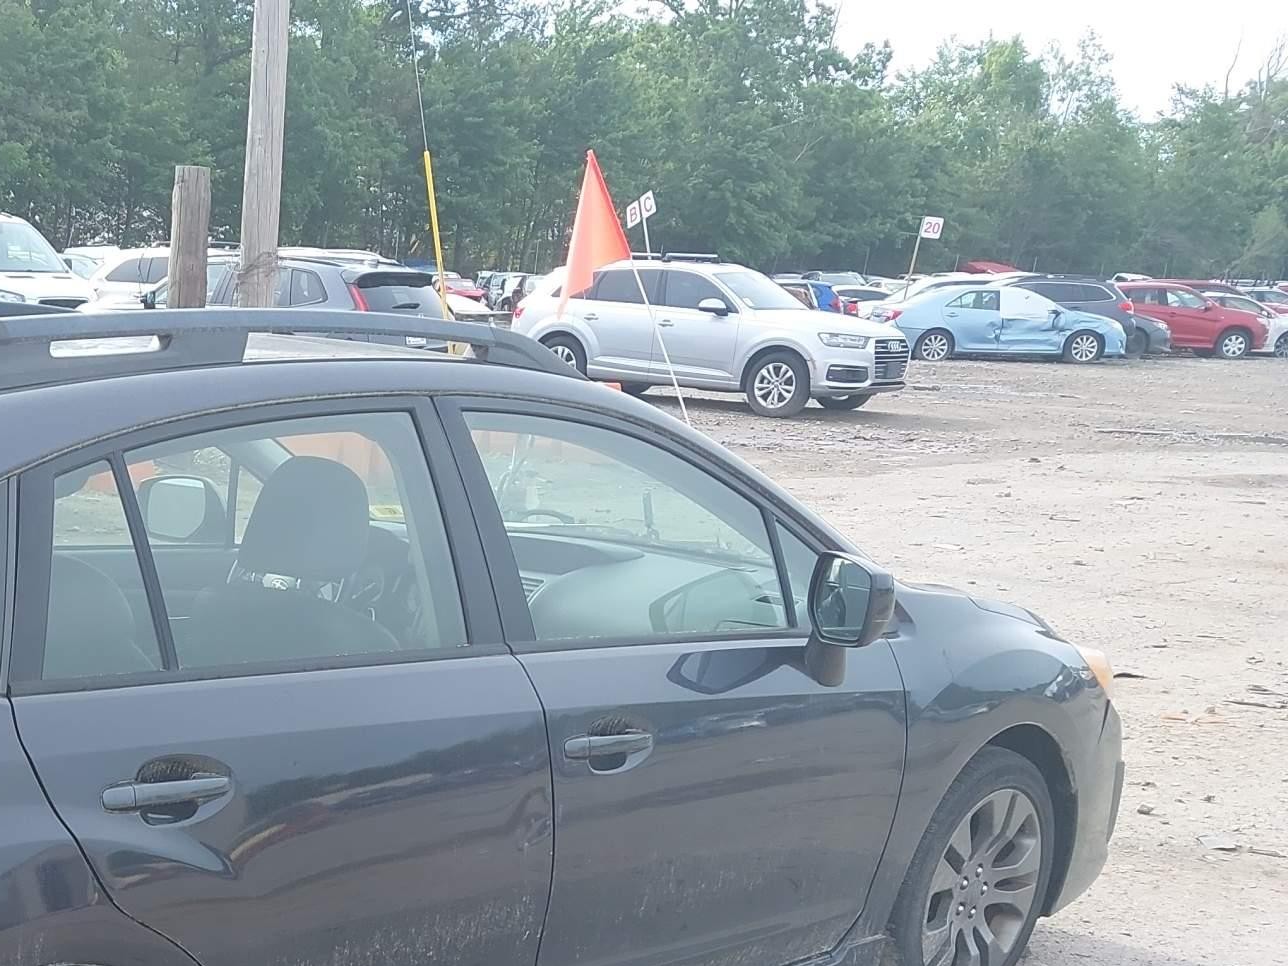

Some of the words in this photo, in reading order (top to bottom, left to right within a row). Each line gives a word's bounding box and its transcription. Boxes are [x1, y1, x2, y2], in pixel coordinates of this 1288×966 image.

[644, 196, 652, 212] C
[630, 206, 637, 223] B
[924, 221, 941, 234] 20
